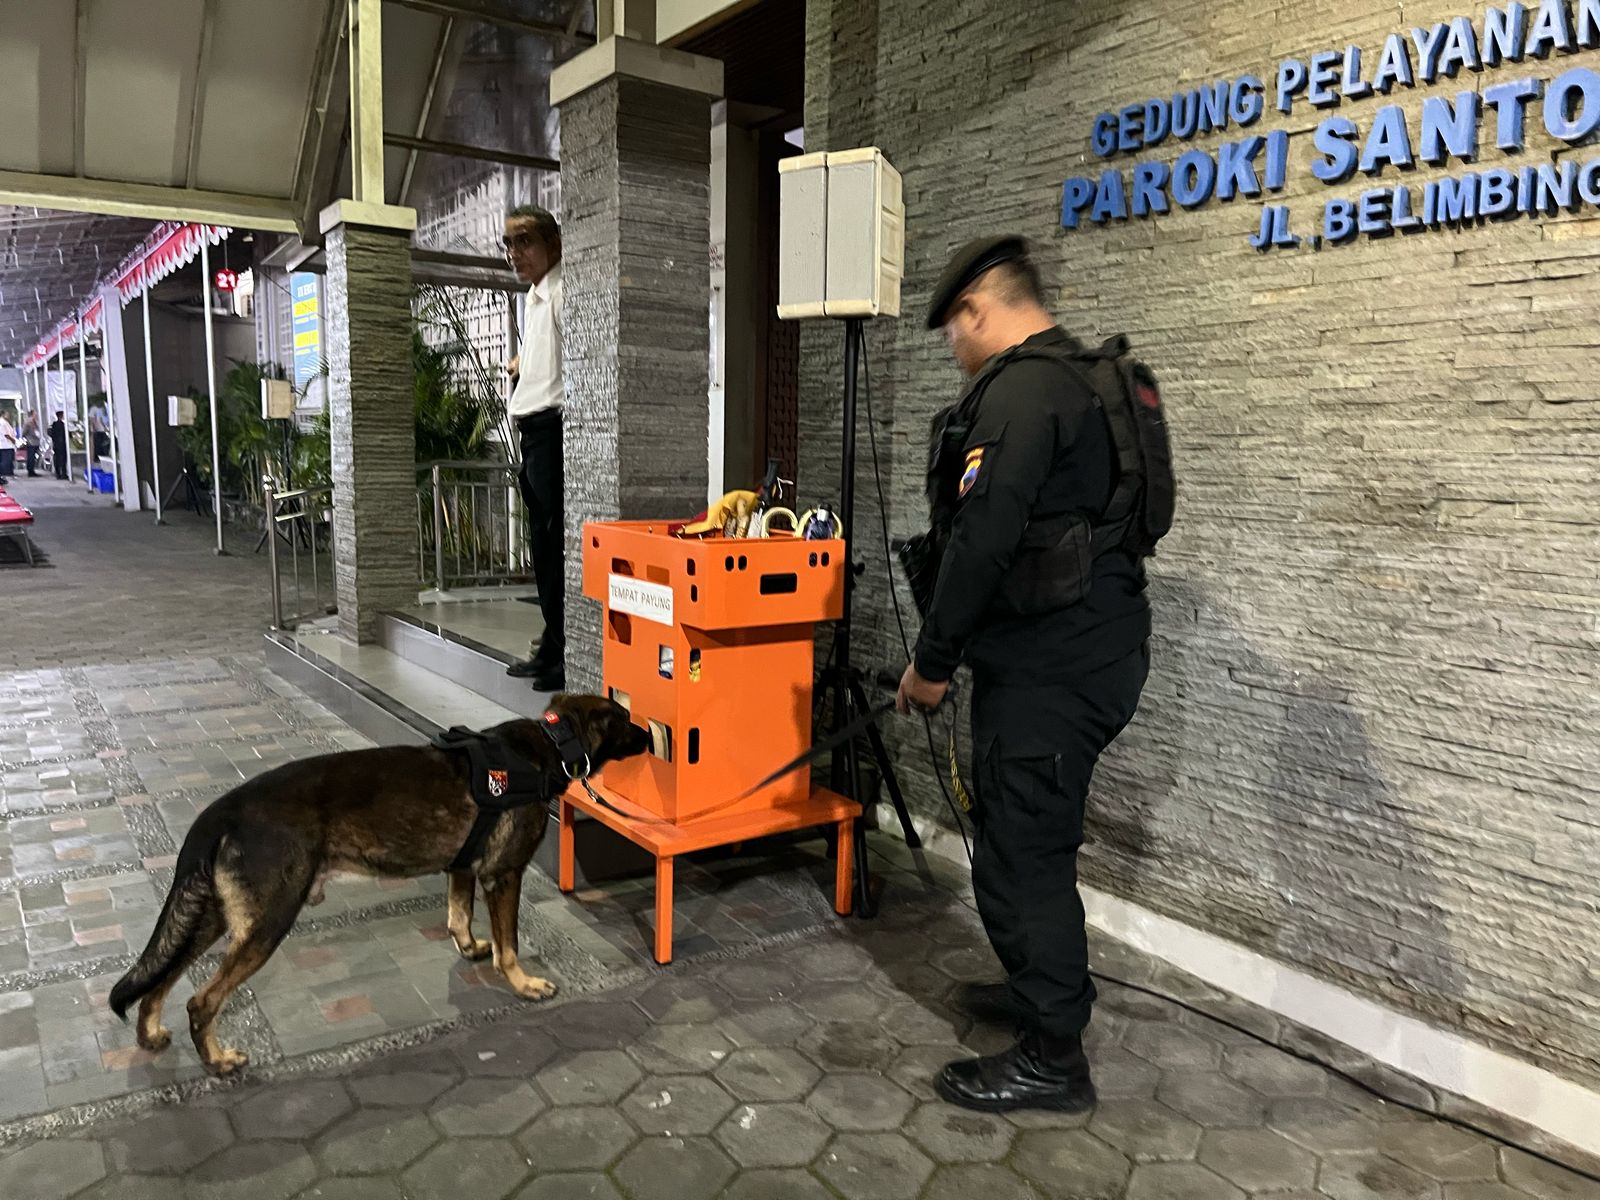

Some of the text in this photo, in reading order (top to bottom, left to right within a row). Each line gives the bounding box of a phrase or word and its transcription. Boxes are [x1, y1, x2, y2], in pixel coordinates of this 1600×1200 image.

[1091, 0, 1600, 157] GEDUNG PELAYANAN
[1062, 67, 1600, 228] PAROKI SANTO
[1324, 158, 1600, 242] BELIMBING
[217, 272, 236, 288] 21
[610, 584, 671, 611] TEMPAT PAYUNG
